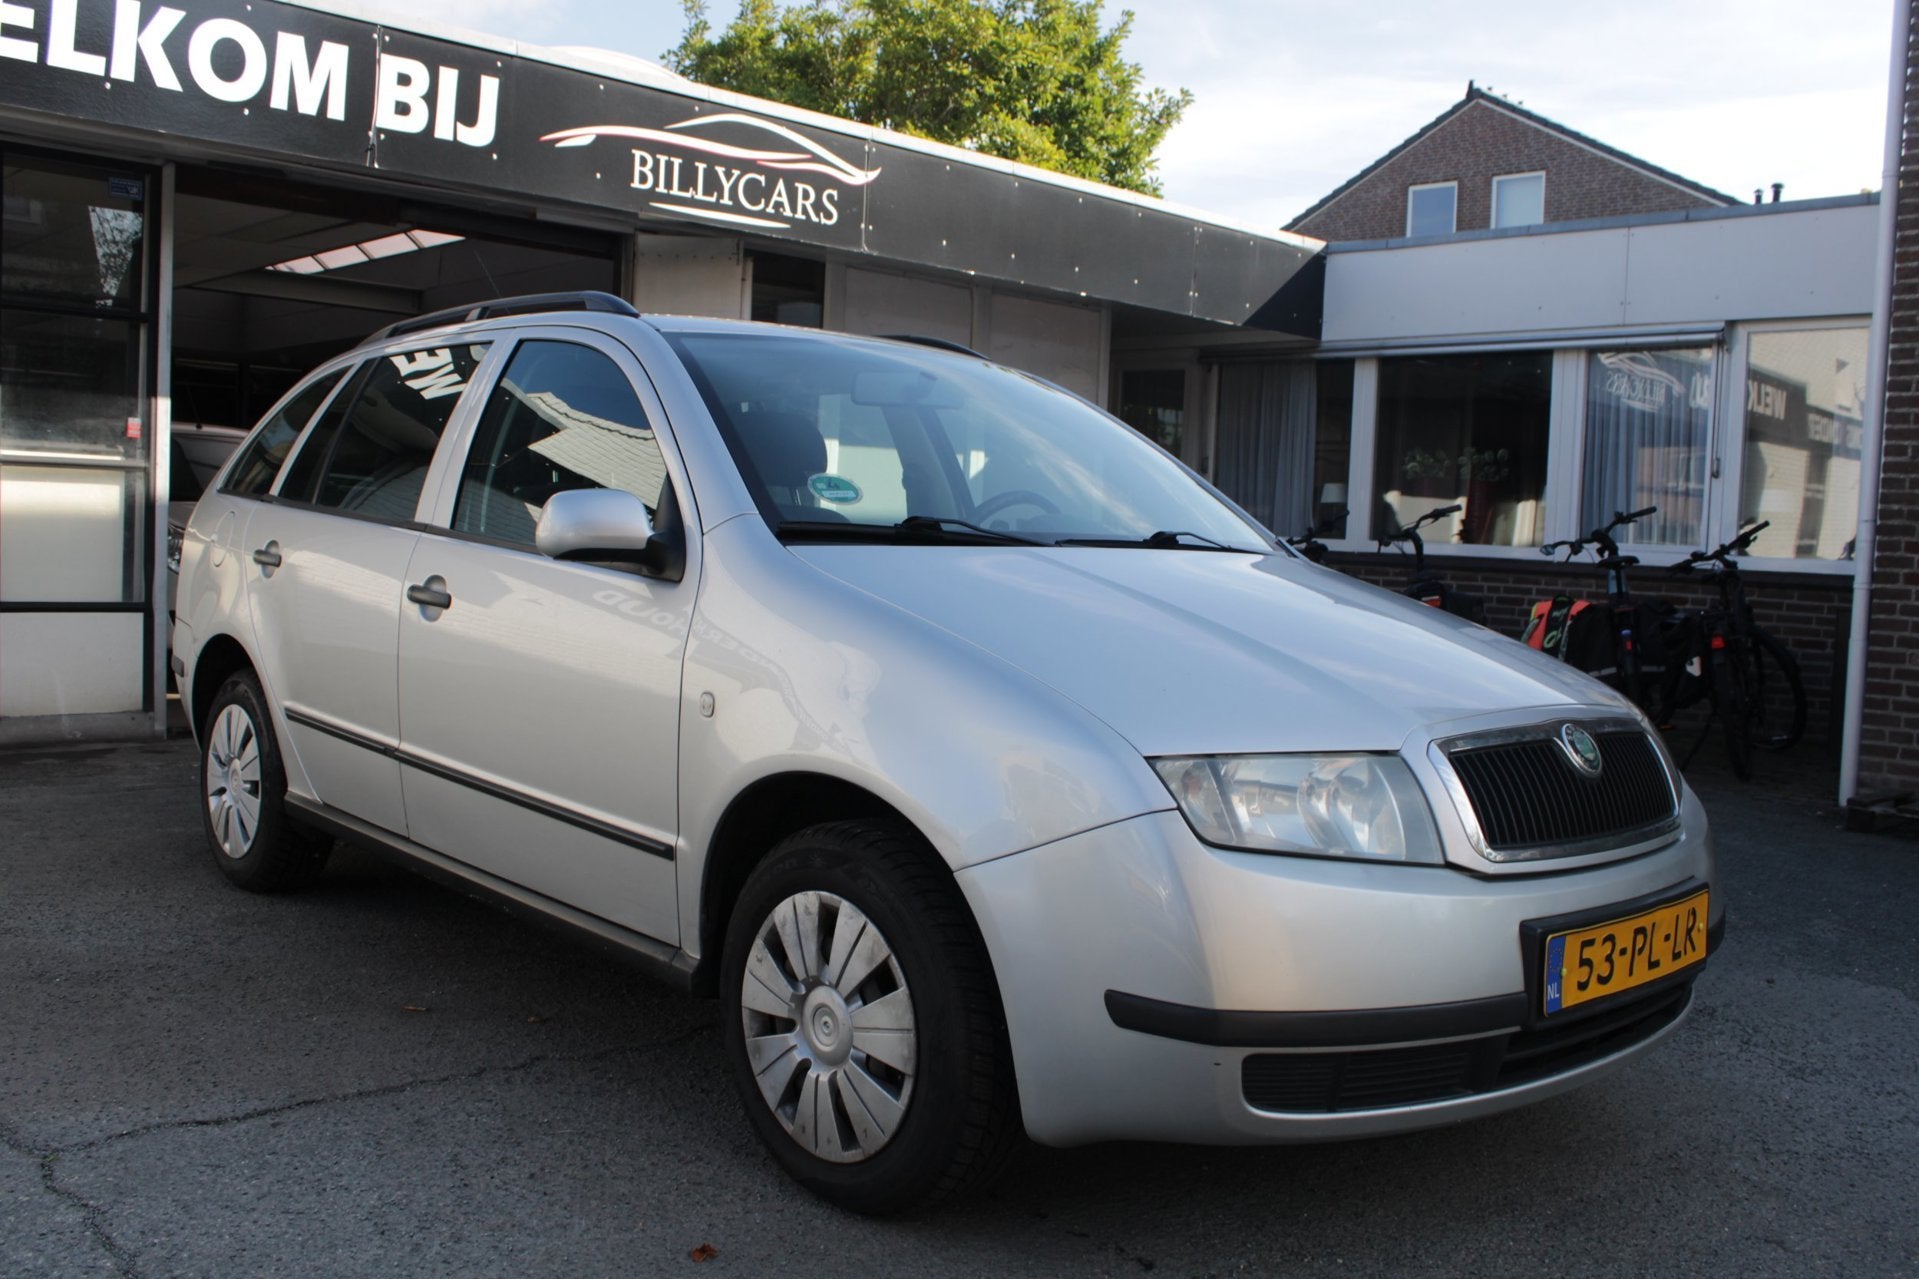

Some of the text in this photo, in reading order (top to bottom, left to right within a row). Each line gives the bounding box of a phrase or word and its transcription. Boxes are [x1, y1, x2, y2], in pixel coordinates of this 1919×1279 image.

[375, 53, 500, 147] BIJ
[630, 149, 839, 226] BILLYCARS
[1576, 907, 1697, 992] 53-PL-LR
[1547, 982, 1560, 1000] NL
